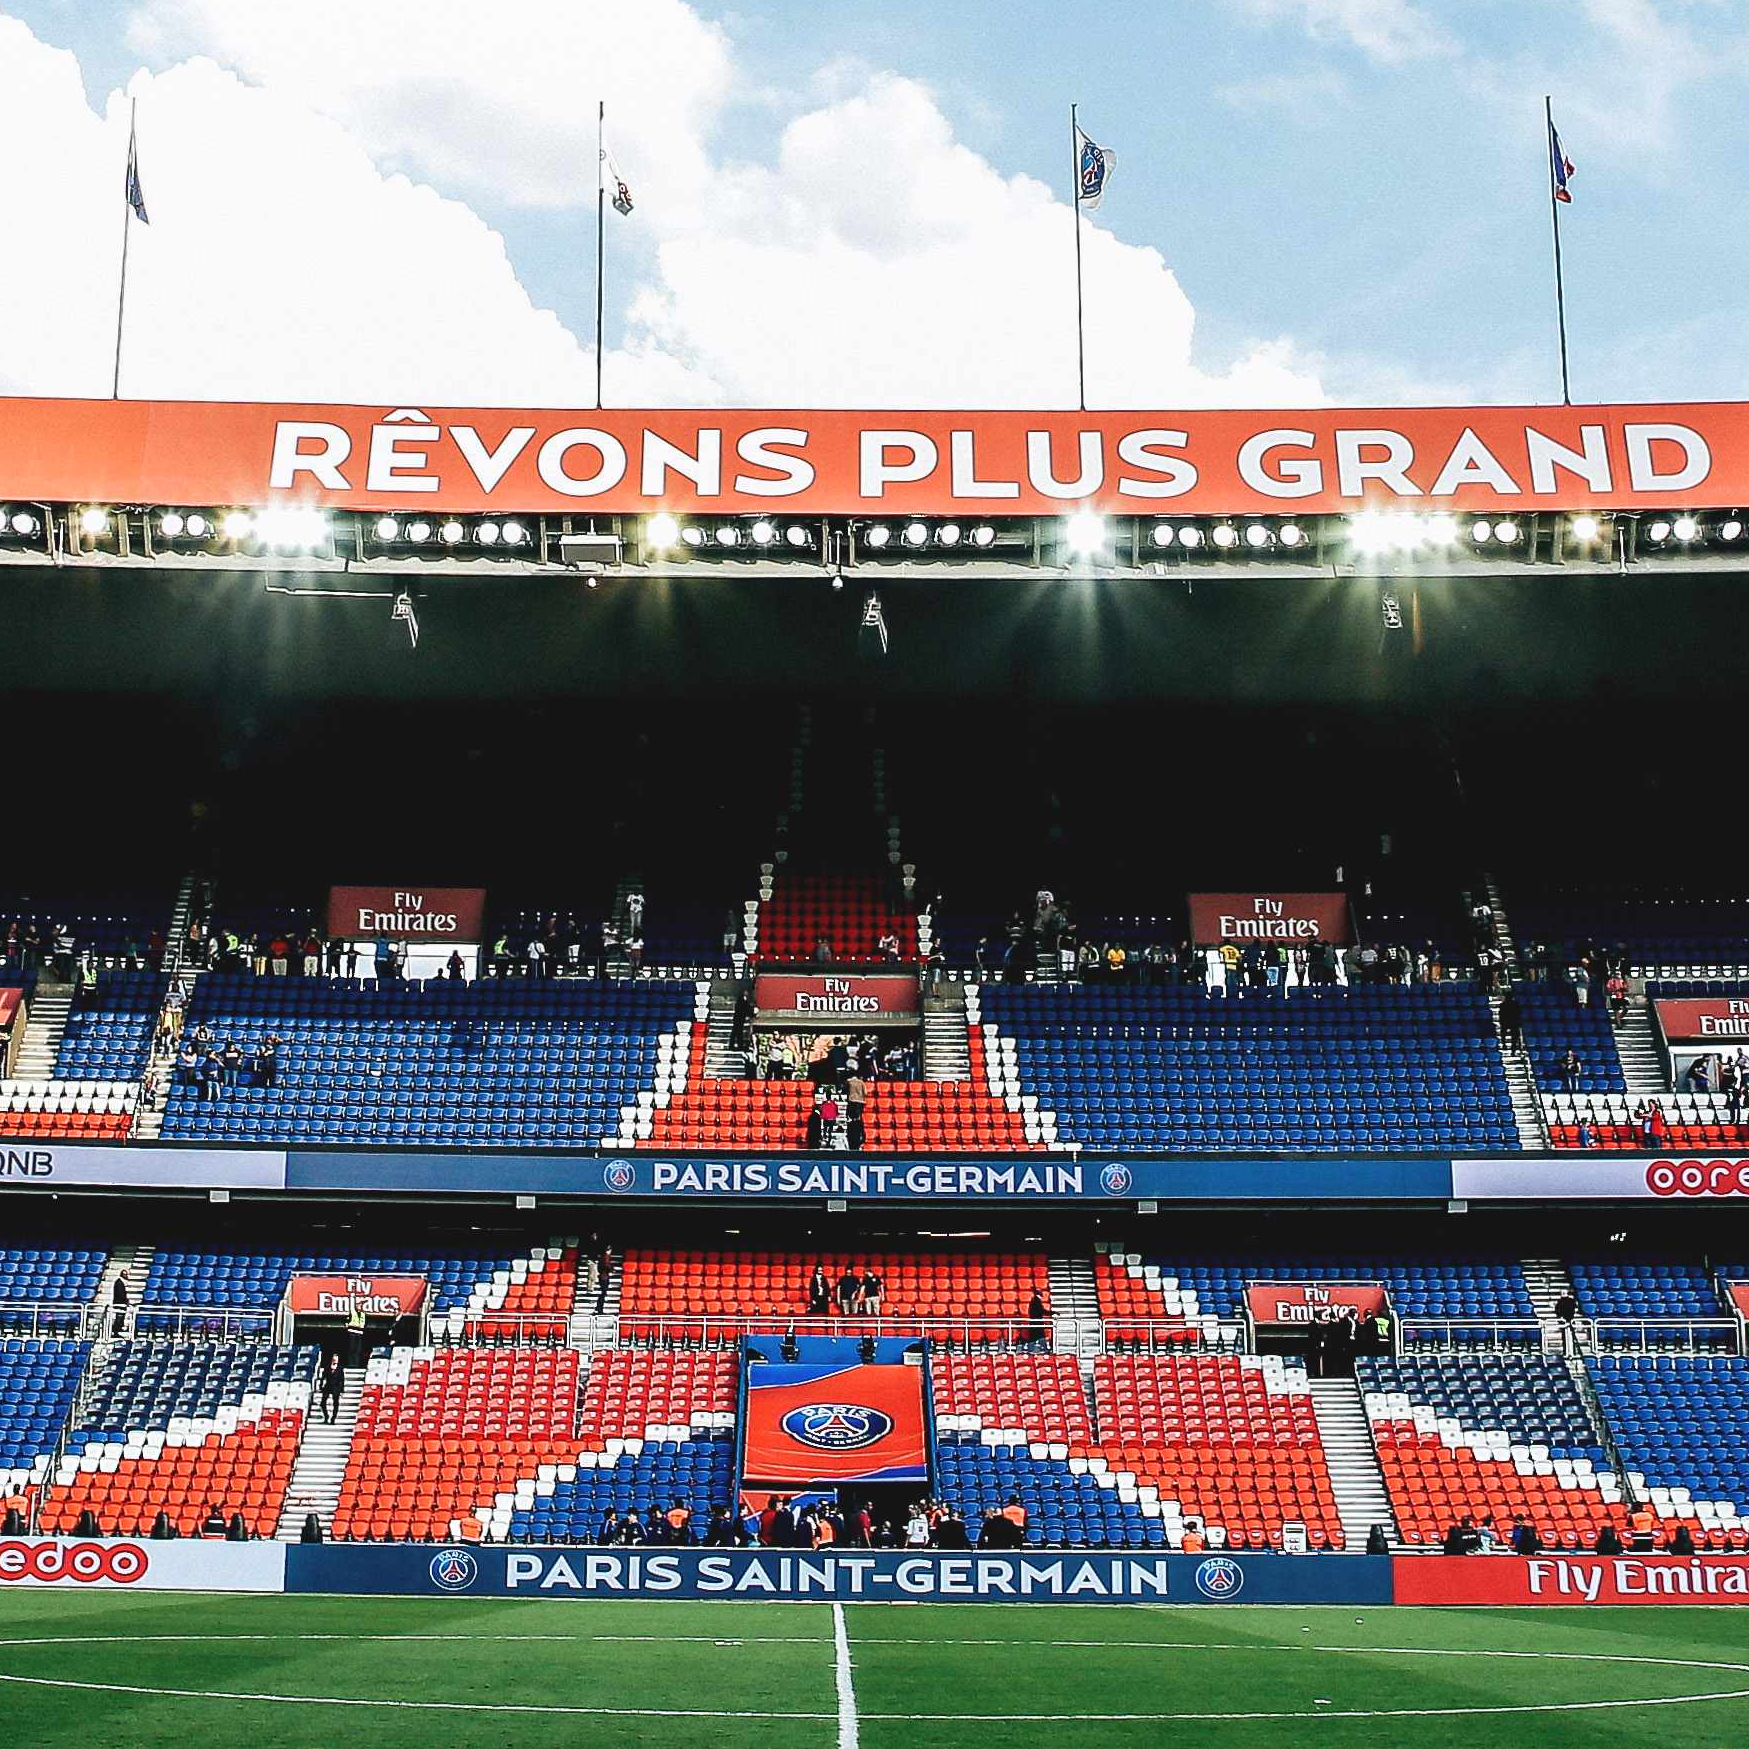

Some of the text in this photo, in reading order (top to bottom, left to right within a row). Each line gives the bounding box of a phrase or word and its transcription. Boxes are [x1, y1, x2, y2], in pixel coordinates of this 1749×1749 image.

[269, 408, 1712, 499] RÊVONS PLUS GRAND
[394, 892, 422, 911] Fly
[1254, 900, 1283, 916] Fly
[359, 908, 457, 932] Emirates
[1220, 916, 1319, 939] Emirates
[825, 978, 851, 994] Fly
[796, 991, 879, 1013] Emirates
[653, 1164, 1083, 1195] PARIS SAINT-GERMAIN
[347, 1278, 372, 1295] Fly
[1304, 1287, 1330, 1304] Fly
[319, 1292, 399, 1313] Emirates
[507, 1553, 1168, 1596] PARIS SAINT-GERMAIN
[1529, 1559, 1603, 1601] Fly
